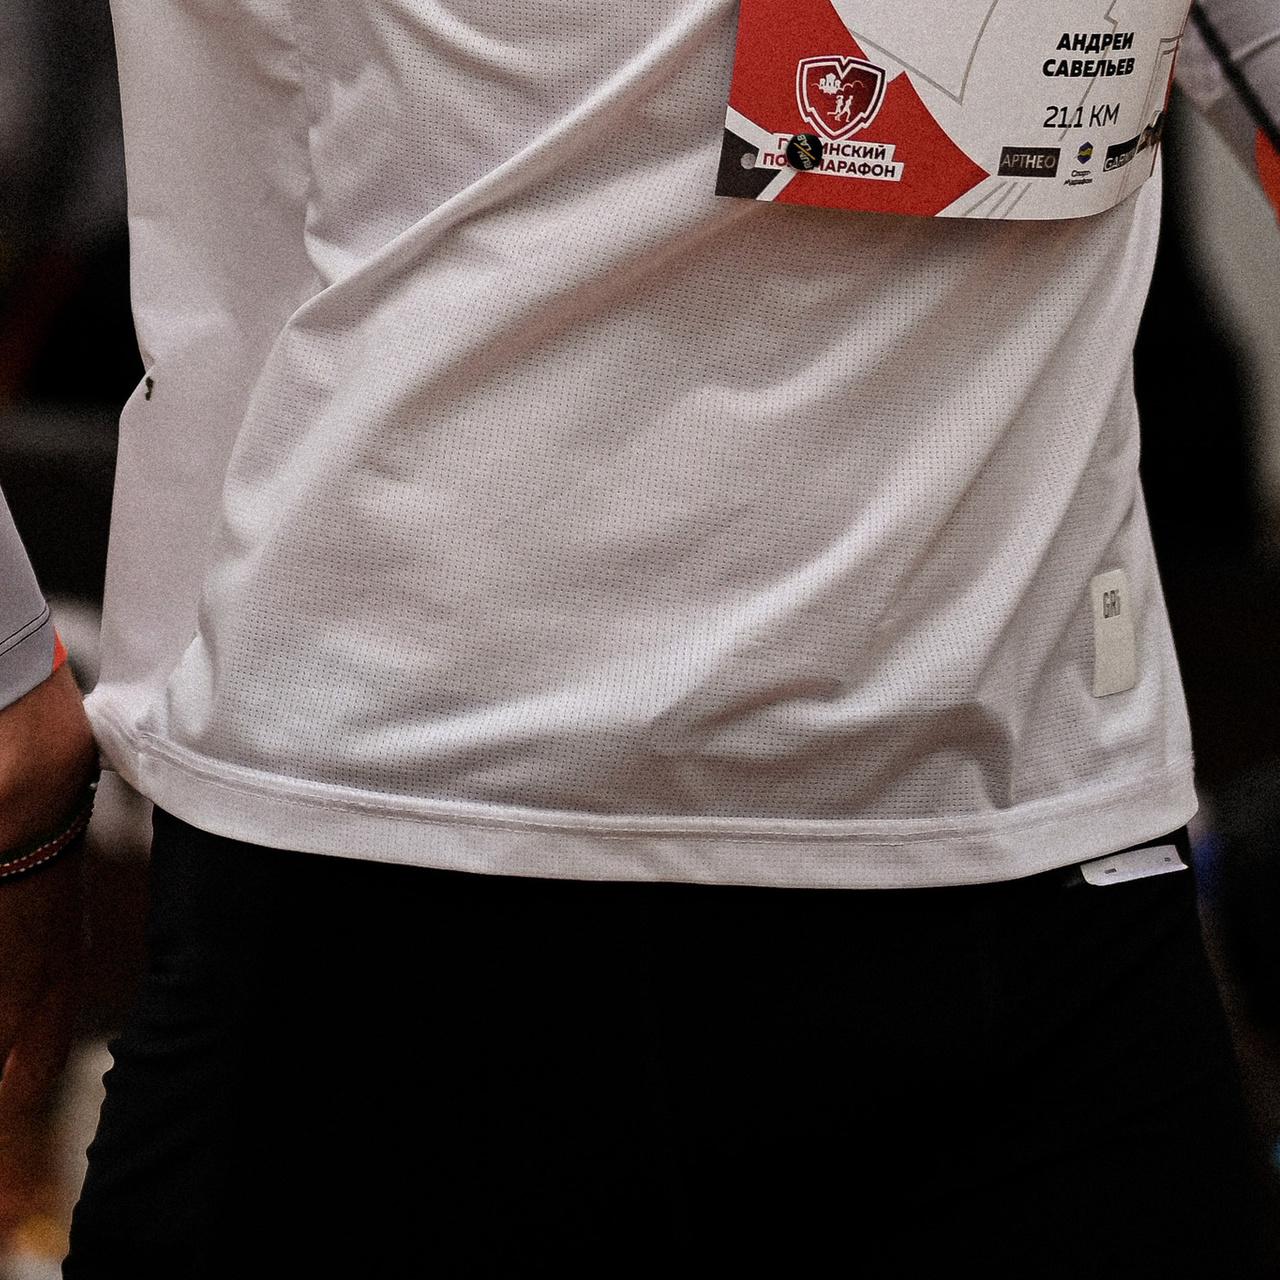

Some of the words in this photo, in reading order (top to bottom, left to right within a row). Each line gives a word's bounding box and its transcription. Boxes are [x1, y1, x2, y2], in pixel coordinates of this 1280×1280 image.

[1042, 58, 1135, 77] САВЕЛЬЕВ
[1043, 105, 1083, 128] 21.1
[796, 134, 812, 151] LAB
[763, 153, 896, 178] ПОАРАФОН
